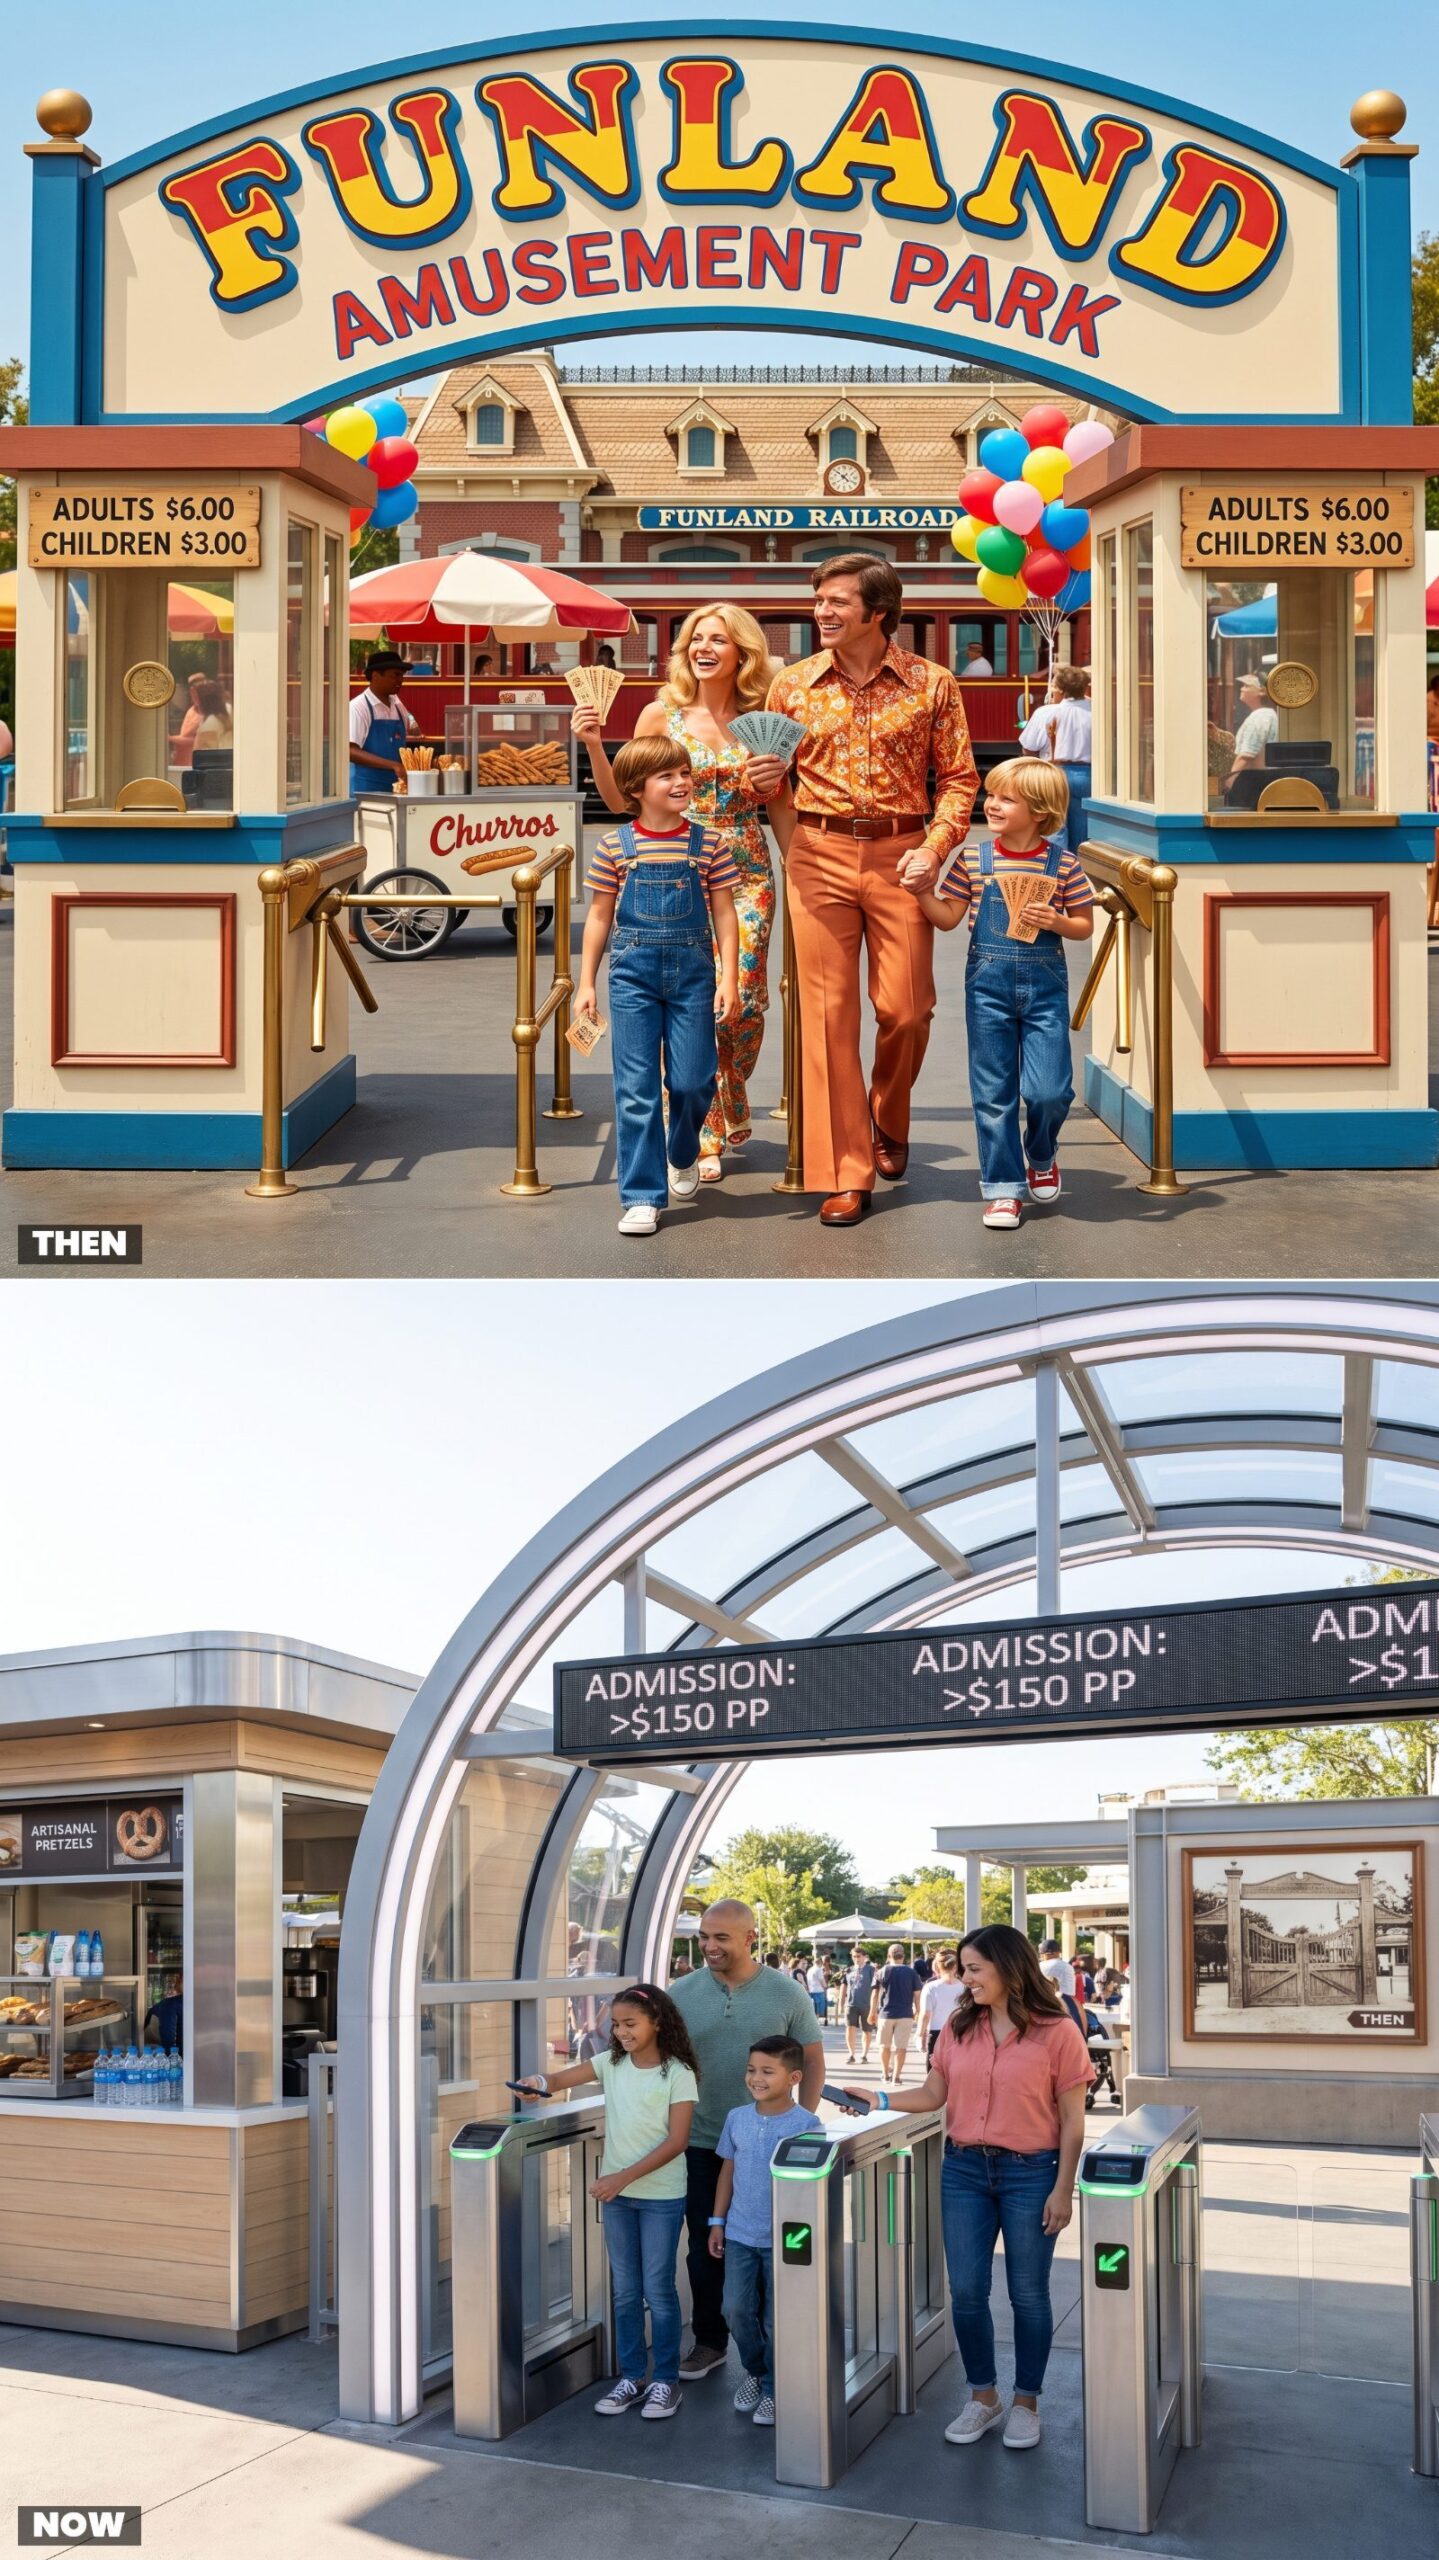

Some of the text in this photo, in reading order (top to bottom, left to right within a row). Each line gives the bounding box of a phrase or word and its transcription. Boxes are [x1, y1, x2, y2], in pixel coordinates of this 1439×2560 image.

[159, 55, 1287, 315] FUNLAND
[332, 225, 1122, 361] AMUSEMENT PARK
[52, 496, 235, 522] ADULTS $6.00
[658, 509, 958, 527] FUNLAND RAILROAD
[1208, 496, 1390, 522] ADULTS $6.00
[41, 531, 247, 556] CHILDREN $3.00
[1196, 531, 1403, 556] CHILDREN $3.00
[430, 813, 560, 857] Churros
[912, 1624, 1168, 1676] ADMISSION:
[585, 1658, 797, 1703] ADMISSION:
[943, 1669, 1137, 1716] >$150 PP
[609, 1698, 771, 1740] >$150 PP
[31, 1822, 97, 1837] ARTISANAL
[35, 1837, 93, 1851] PRETZELS
[1360, 2013, 1405, 2025] THEN
